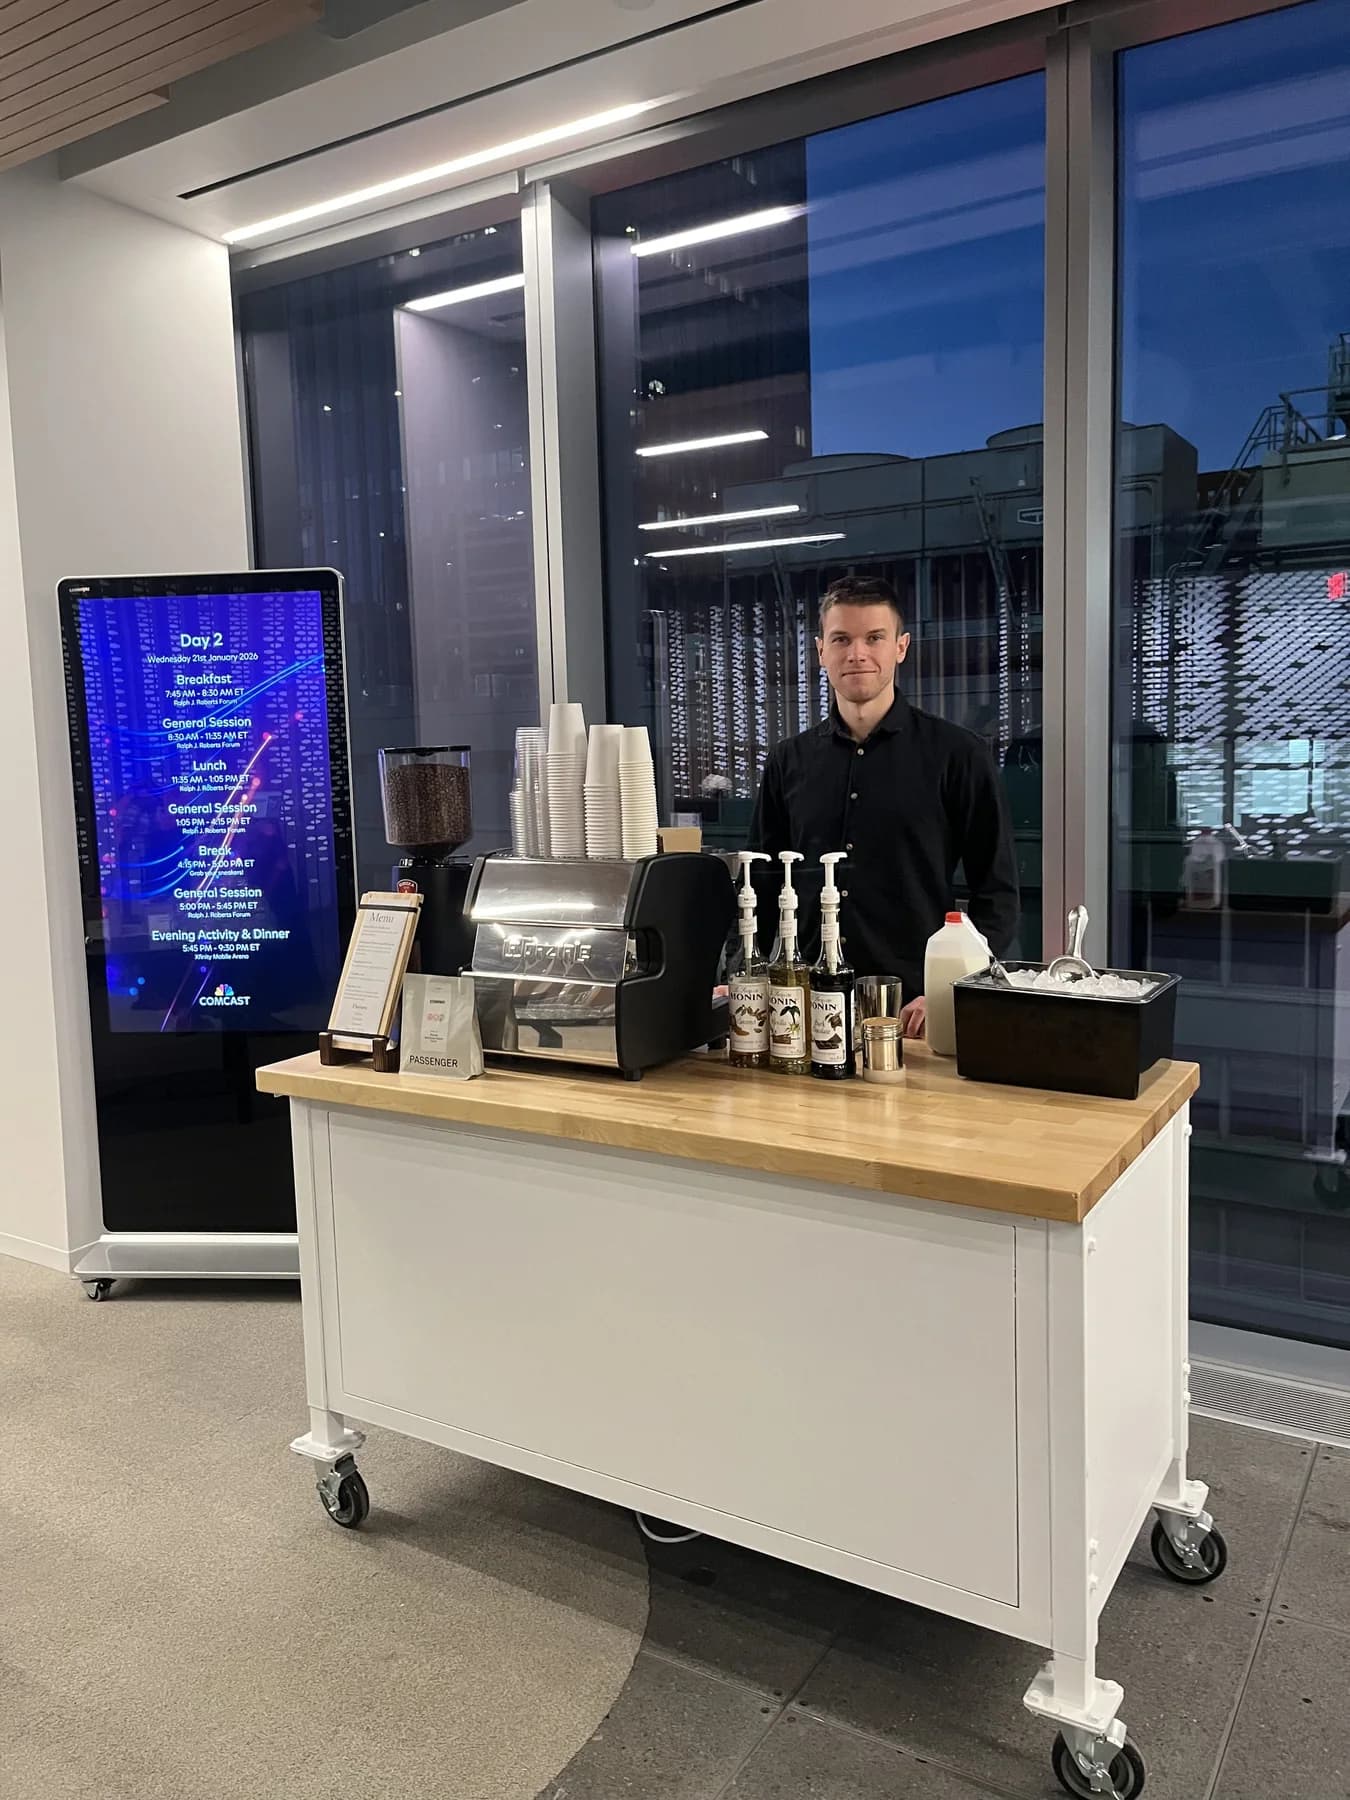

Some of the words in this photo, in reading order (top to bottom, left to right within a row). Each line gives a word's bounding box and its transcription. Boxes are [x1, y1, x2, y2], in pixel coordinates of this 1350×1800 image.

[180, 633, 210, 650] Day
[213, 633, 224, 647] 2
[147, 655, 191, 664] Wednesday
[192, 654, 207, 662] 21st
[208, 654, 238, 662] January
[239, 653, 259, 661] 2026
[176, 673, 232, 685] Breakfast
[165, 690, 181, 698] 7:45
[201, 689, 219, 697] 8:30
[219, 688, 234, 696] AM
[234, 688, 245, 696] ET
[162, 717, 207, 729] General
[208, 716, 252, 728] Session
[168, 733, 185, 741] 8:30
[185, 732, 199, 740] AM
[205, 732, 222, 740] 11:35
[238, 731, 249, 739] ET
[193, 760, 227, 771] Lunch
[171, 776, 189, 784] 11:35
[209, 775, 224, 783] 1:05
[239, 774, 250, 782] ET
[168, 803, 212, 814] General
[214, 802, 257, 813] Session
[191, 818, 205, 826] PM
[226, 817, 239, 825] PM
[198, 846, 232, 856] Break
[230, 859, 244, 867] PM
[244, 859, 255, 867] ET
[174, 887, 218, 899] General
[220, 887, 262, 898] Session
[180, 903, 197, 911] 5:00
[197, 902, 211, 910] PM
[216, 902, 233, 910] 5:45
[248, 901, 258, 909] ET
[371, 911, 394, 922] Menu
[152, 930, 196, 942] Evening
[198, 929, 239, 941] Activity
[242, 929, 251, 939] &
[253, 928, 290, 939] Dinner
[200, 944, 212, 952] PM
[250, 943, 260, 951] ET
[199, 996, 251, 1006] COMCAST
[730, 992, 763, 1000] MONIN
[771, 997, 797, 1005] ONIN
[813, 1002, 837, 1010] ONIN
[409, 1055, 458, 1068] PASSENGER
